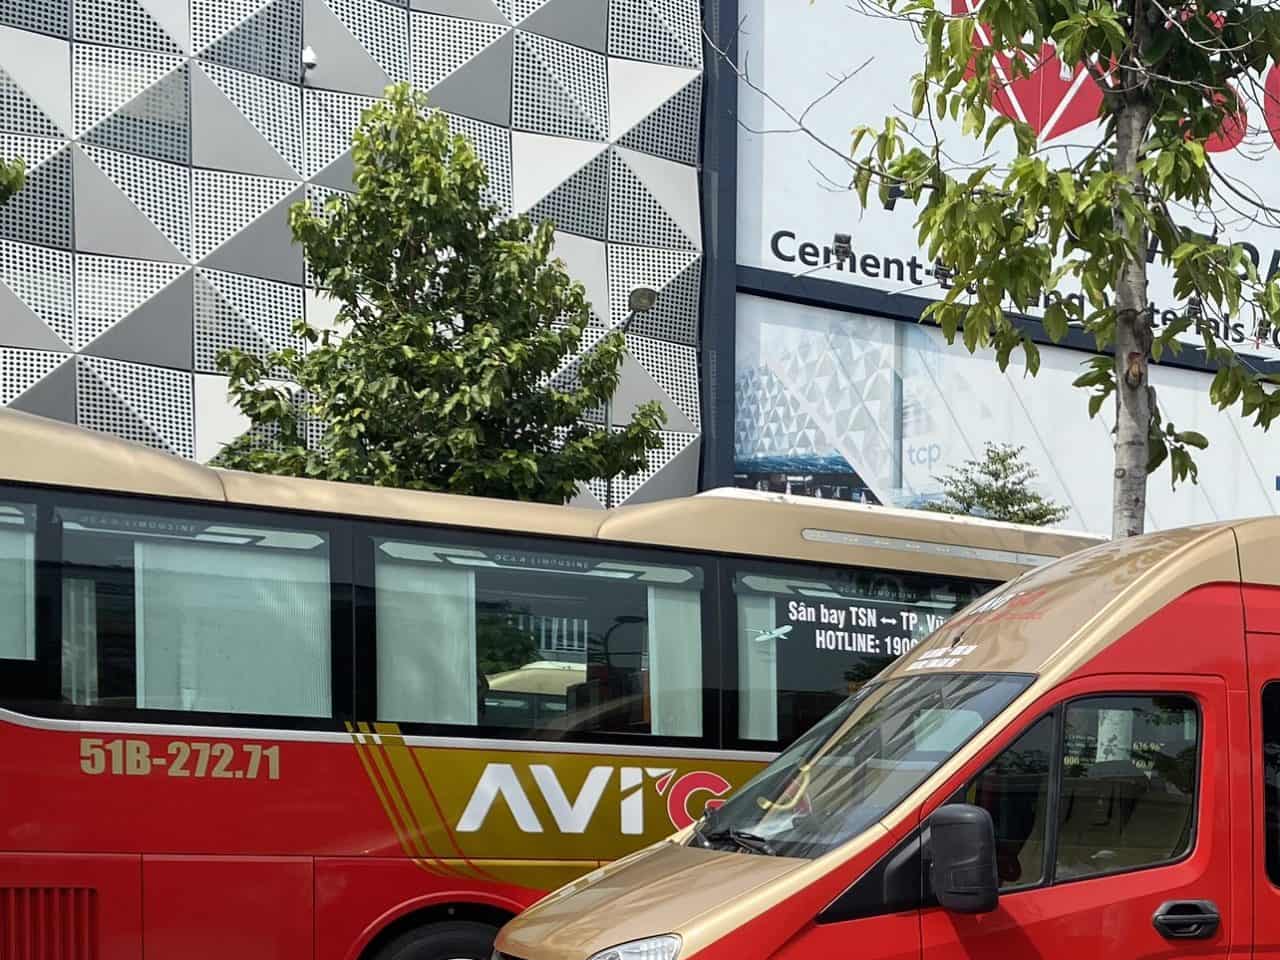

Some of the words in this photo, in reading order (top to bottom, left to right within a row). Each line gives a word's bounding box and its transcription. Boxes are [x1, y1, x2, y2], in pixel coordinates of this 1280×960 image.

[908, 442, 941, 470] tcp
[788, 600, 816, 623] Sân
[820, 603, 846, 629] bay
[849, 606, 877, 628] TSN
[927, 614, 948, 635] Vũ
[815, 629, 881, 654] HOTLINE:
[79, 738, 281, 781] 51B-272.71
